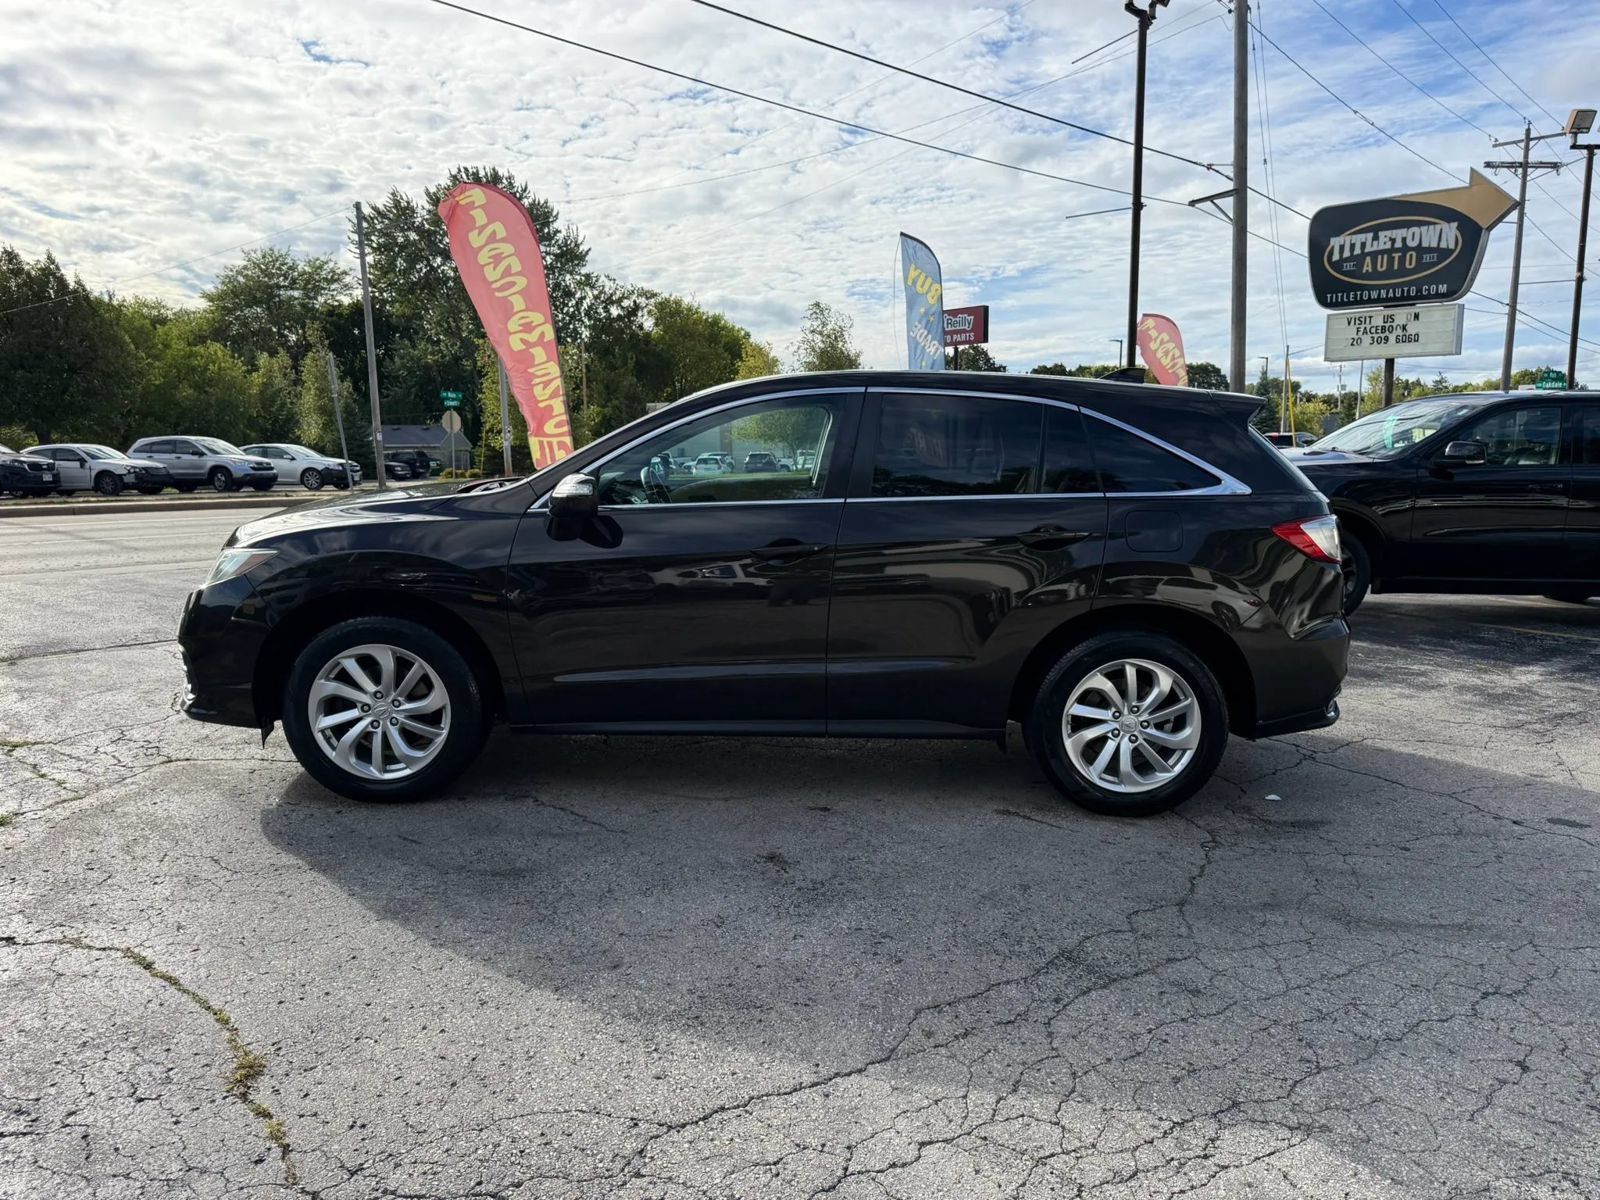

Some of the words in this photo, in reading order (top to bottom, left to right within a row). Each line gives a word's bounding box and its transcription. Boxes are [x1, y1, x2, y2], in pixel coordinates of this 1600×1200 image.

[1329, 221, 1459, 262] TITLETOWN
[1362, 251, 1417, 273] AUTO
[1326, 283, 1448, 303] TITLETOWNAUTO.COM
[944, 313, 974, 330] 'Reilly
[1346, 315, 1374, 326] VISIT
[1383, 314, 1395, 324] US
[1406, 311, 1420, 322] ON
[953, 332, 975, 343] PARTS
[1369, 335, 1389, 345] 309
[1395, 333, 1420, 344] 6060
